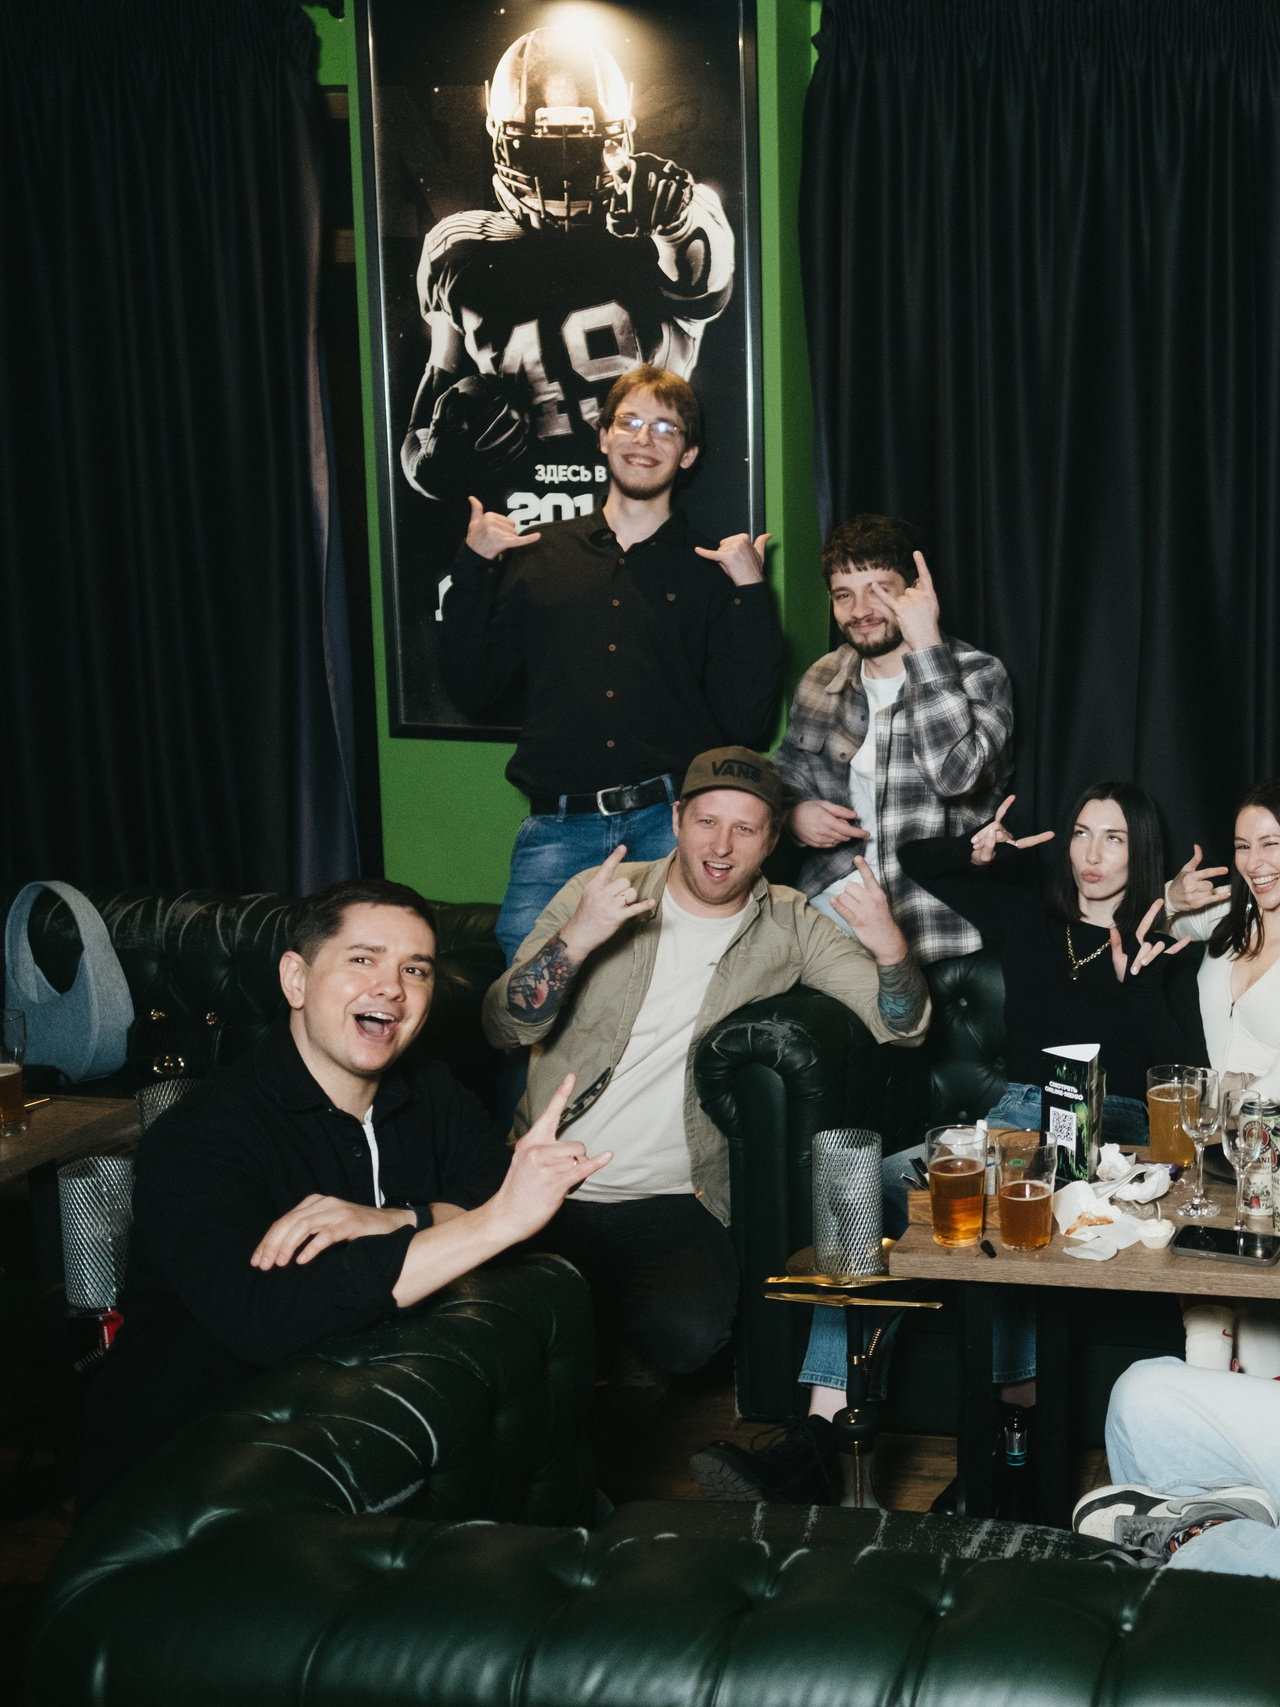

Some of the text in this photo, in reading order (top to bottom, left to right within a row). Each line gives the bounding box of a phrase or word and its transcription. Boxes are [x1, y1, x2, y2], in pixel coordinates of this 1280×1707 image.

[534, 464, 608, 484] ЗДЕСЬ В
[506, 491, 595, 536] 201
[711, 759, 763, 783] VANS
